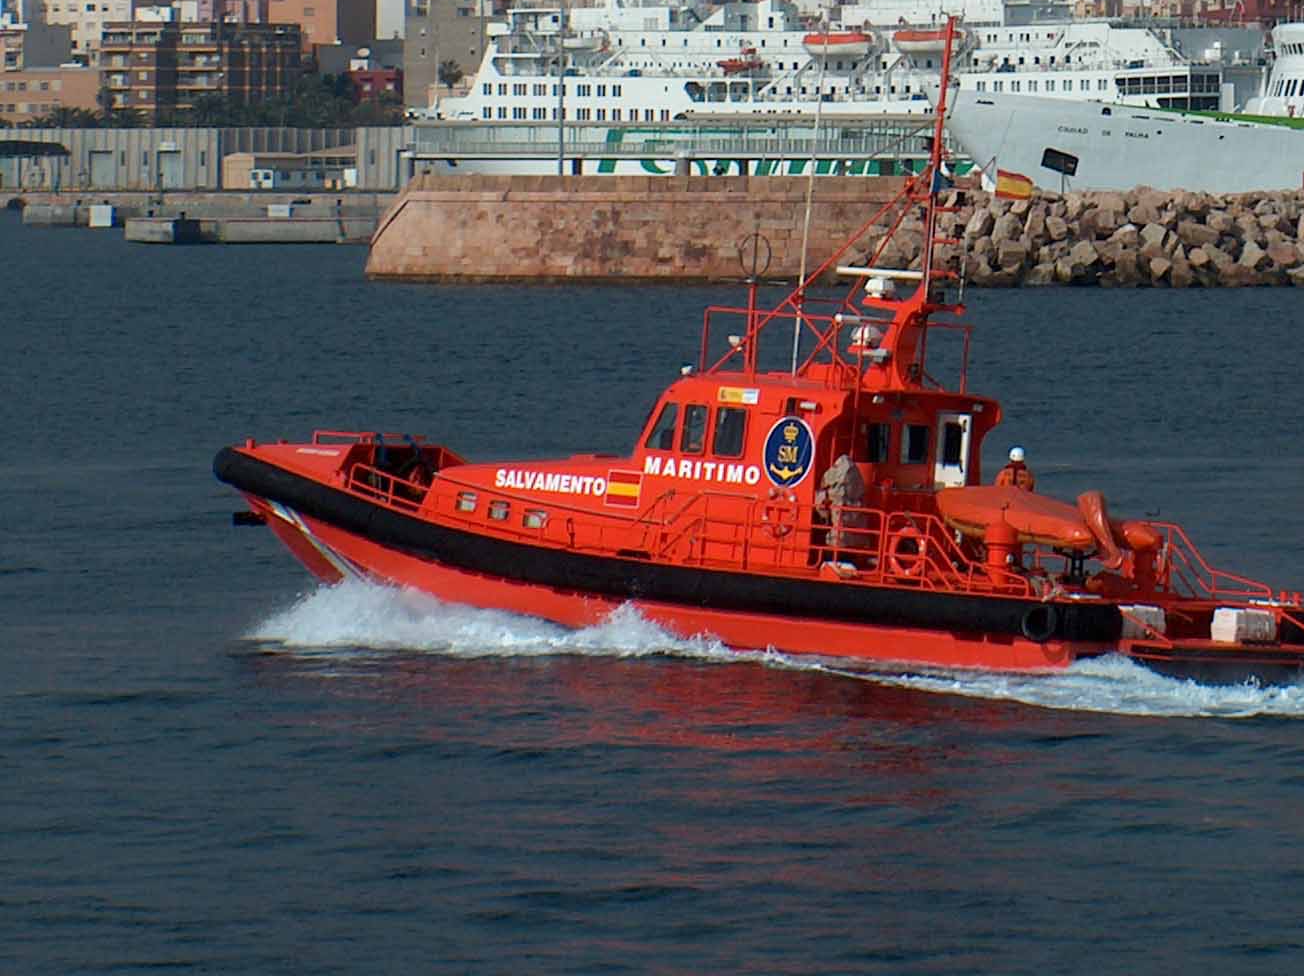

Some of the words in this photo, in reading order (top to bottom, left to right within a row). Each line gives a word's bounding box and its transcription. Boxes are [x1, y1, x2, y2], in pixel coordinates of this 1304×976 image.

[777, 445, 798, 463] SM
[495, 469, 607, 496] SALVAMENTO
[644, 456, 760, 485] MARITIMO
